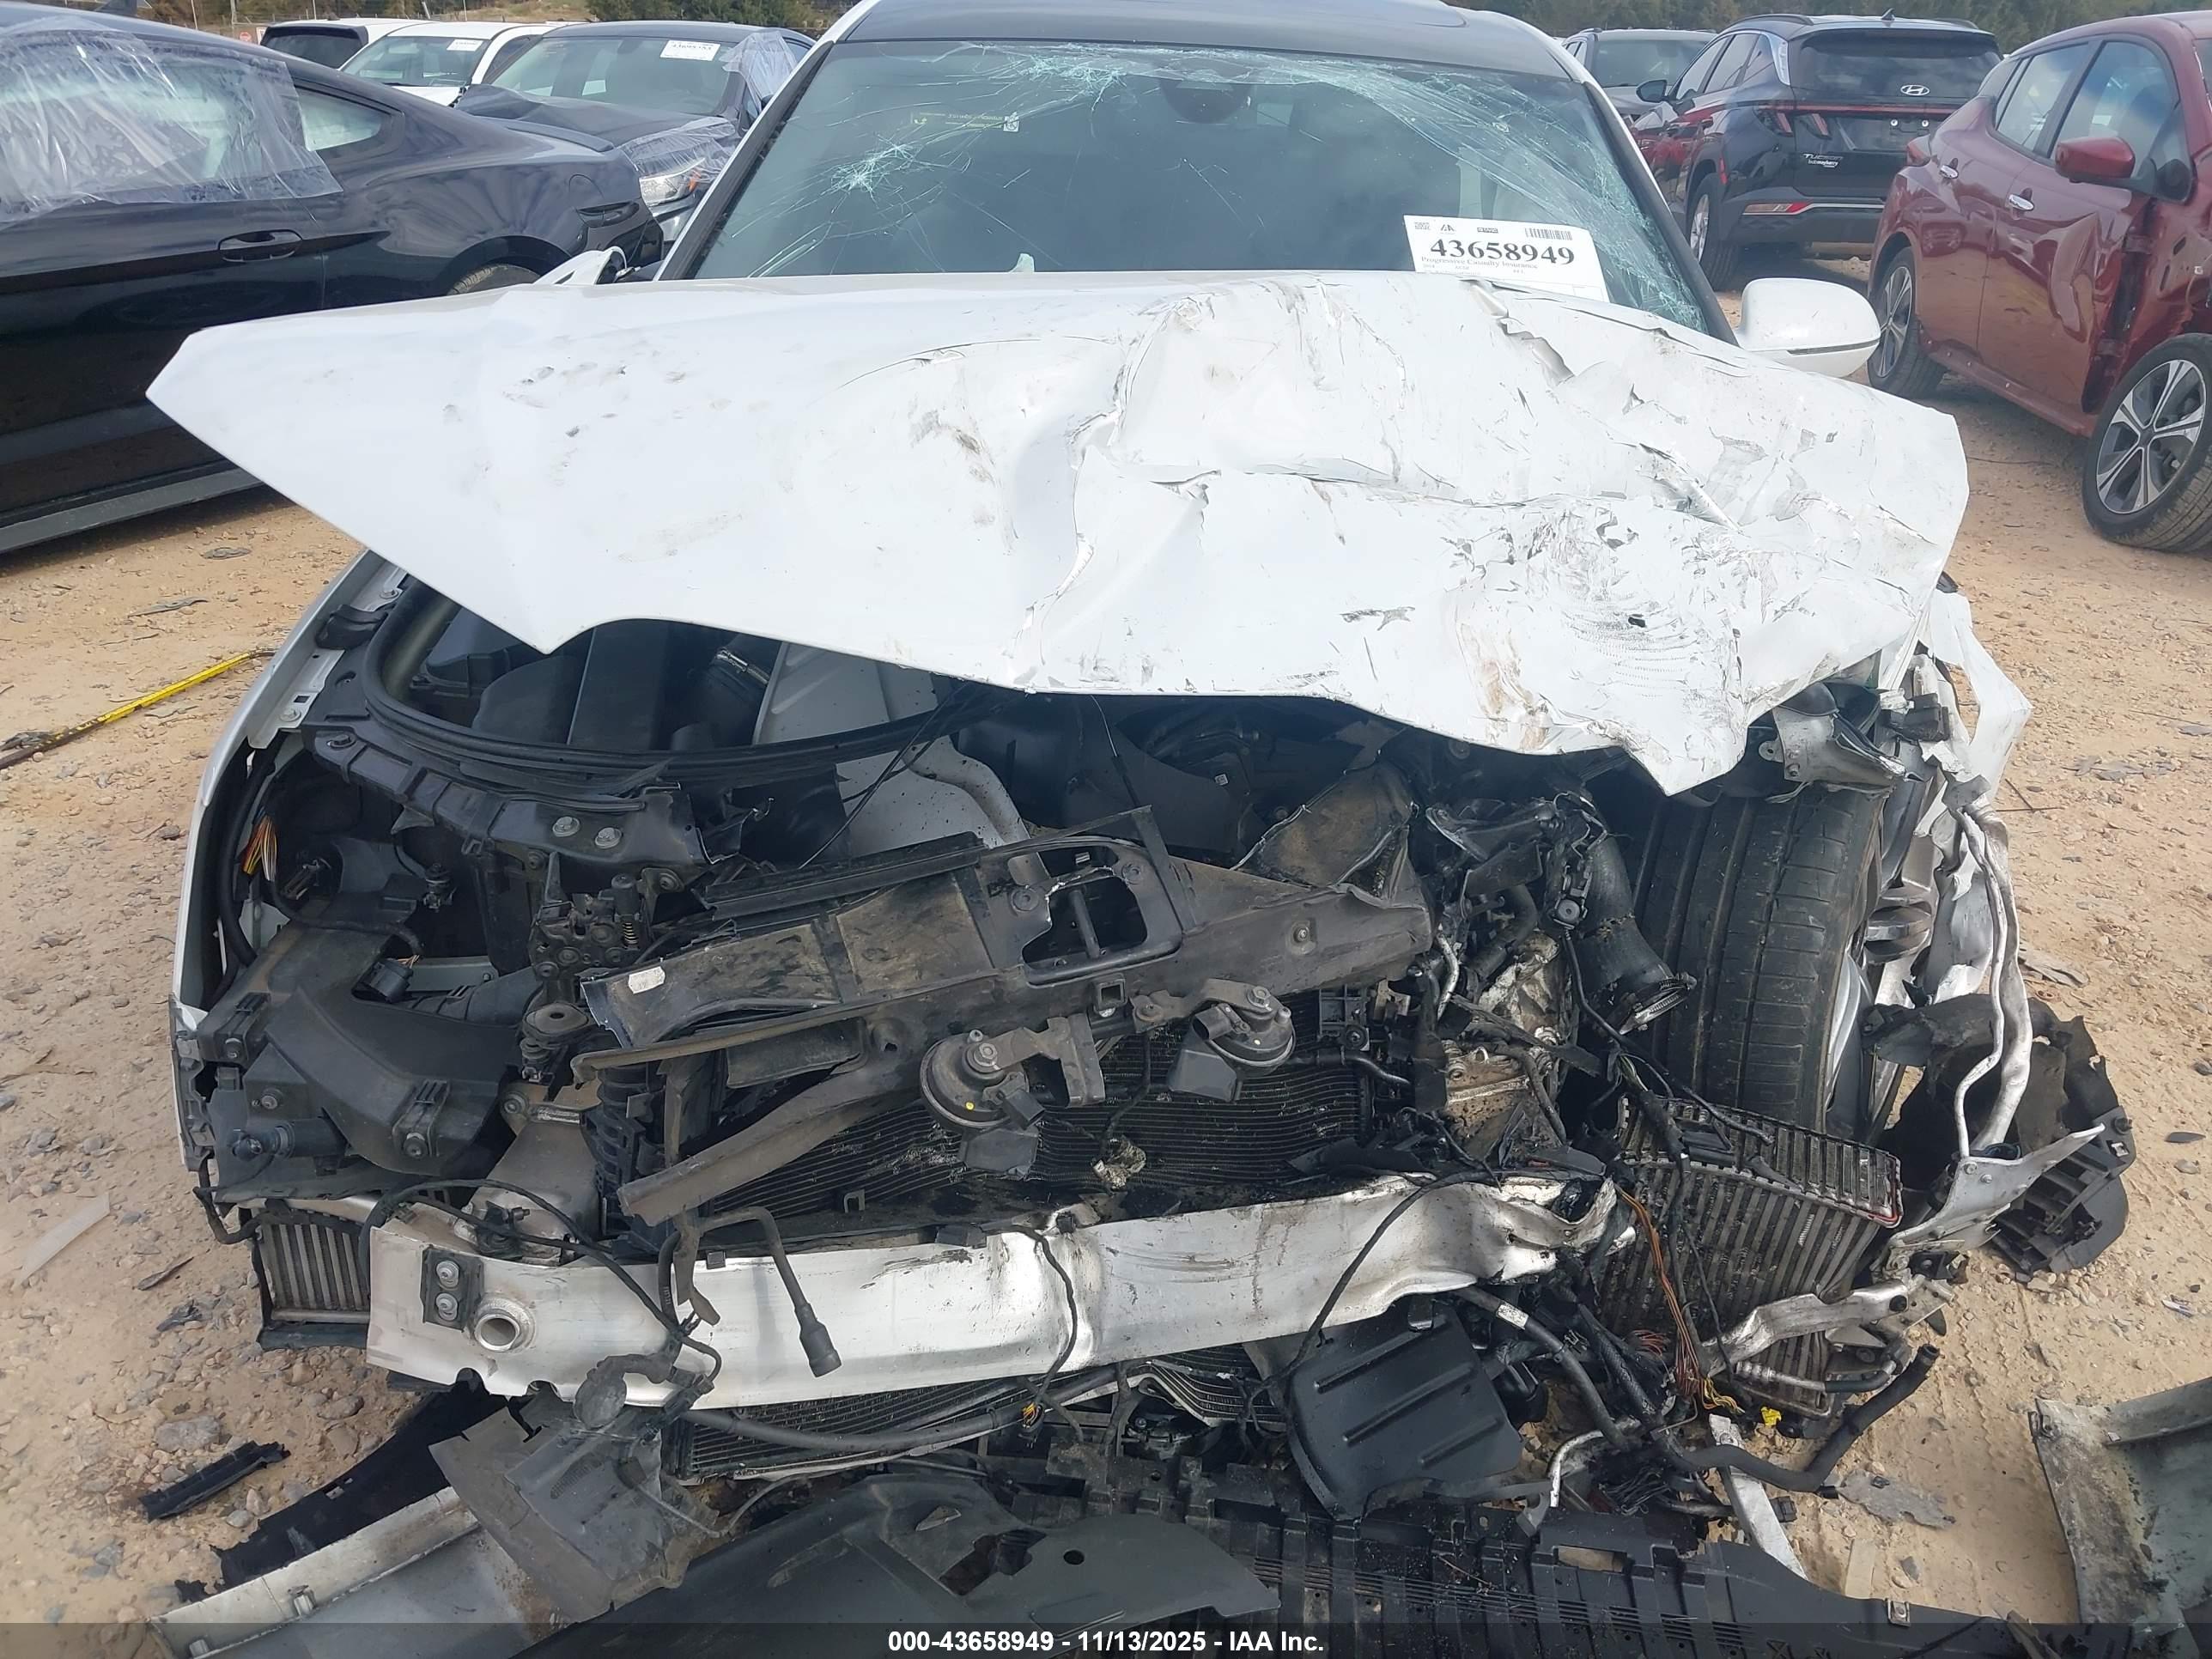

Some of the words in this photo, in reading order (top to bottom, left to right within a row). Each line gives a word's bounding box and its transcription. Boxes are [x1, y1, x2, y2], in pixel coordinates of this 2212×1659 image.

[1421, 255, 1466, 264] Progressive
[1467, 258, 1500, 268] Casualty
[1430, 238, 1575, 265] 43658949
